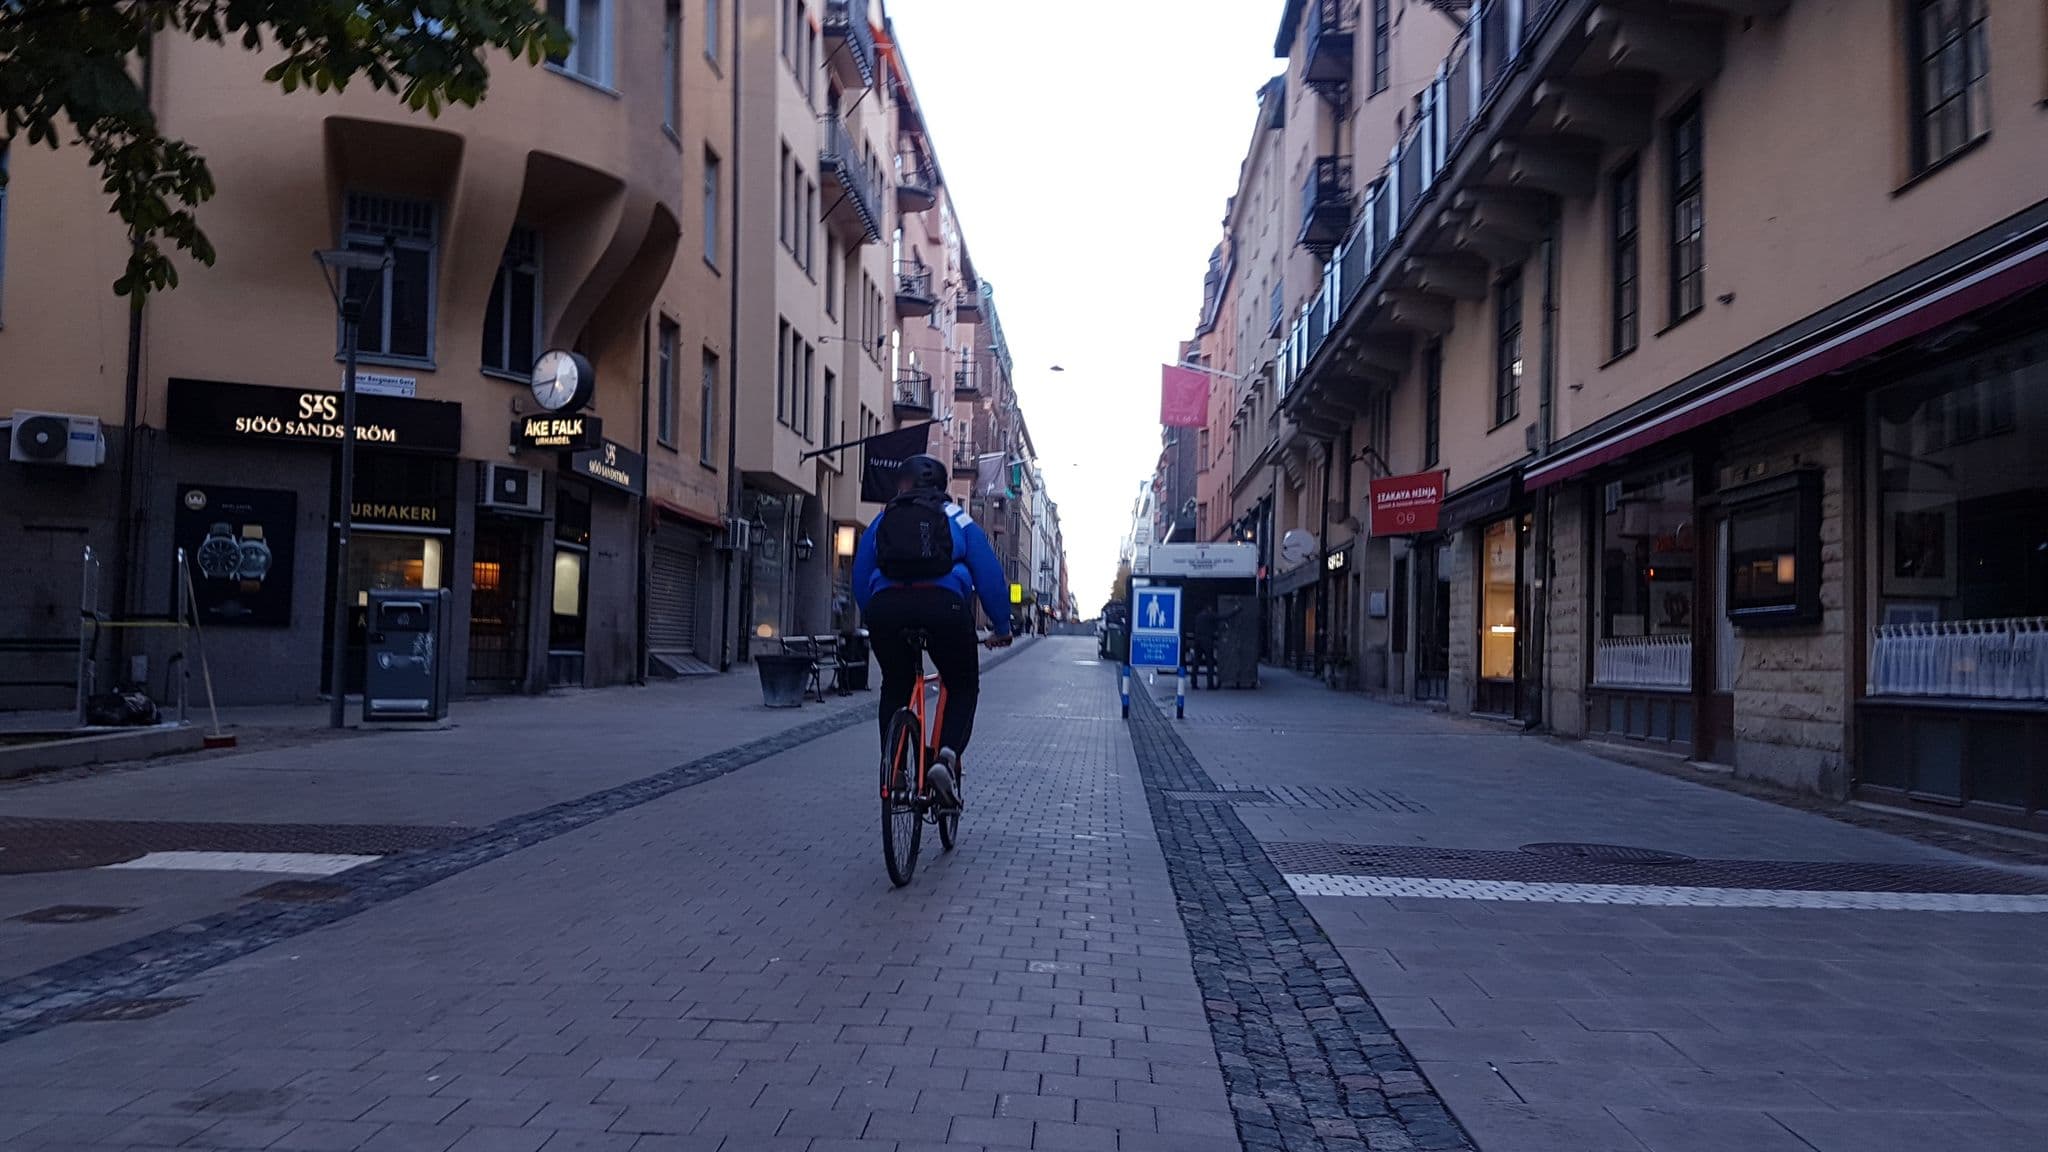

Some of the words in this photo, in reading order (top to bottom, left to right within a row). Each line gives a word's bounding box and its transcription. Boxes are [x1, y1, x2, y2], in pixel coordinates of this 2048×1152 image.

[235, 416, 282, 434] SJÖÖ
[285, 421, 396, 442] SANDSRÖM
[524, 418, 549, 437] ÅKE
[551, 419, 583, 436] FALK
[1377, 489, 1410, 503] IZAKAYA
[1411, 486, 1437, 499] NINJA
[351, 503, 436, 521] URMAKERI
